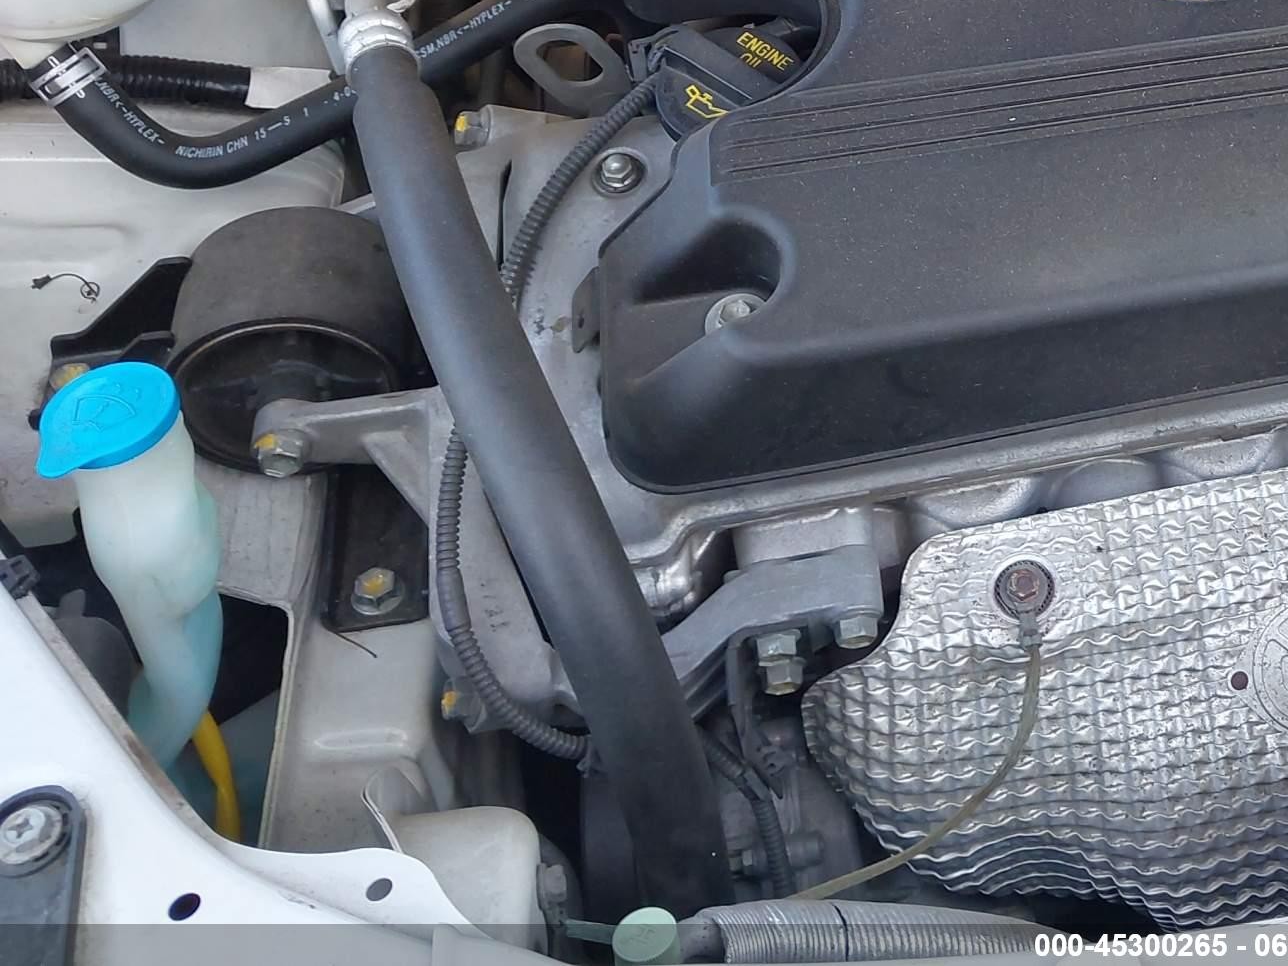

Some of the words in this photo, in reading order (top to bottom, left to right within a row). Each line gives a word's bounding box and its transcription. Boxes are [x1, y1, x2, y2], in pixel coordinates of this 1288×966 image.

[736, 32, 795, 71] ENGINE
[175, 144, 224, 158] NICHIRIN
[226, 135, 249, 154] CHN
